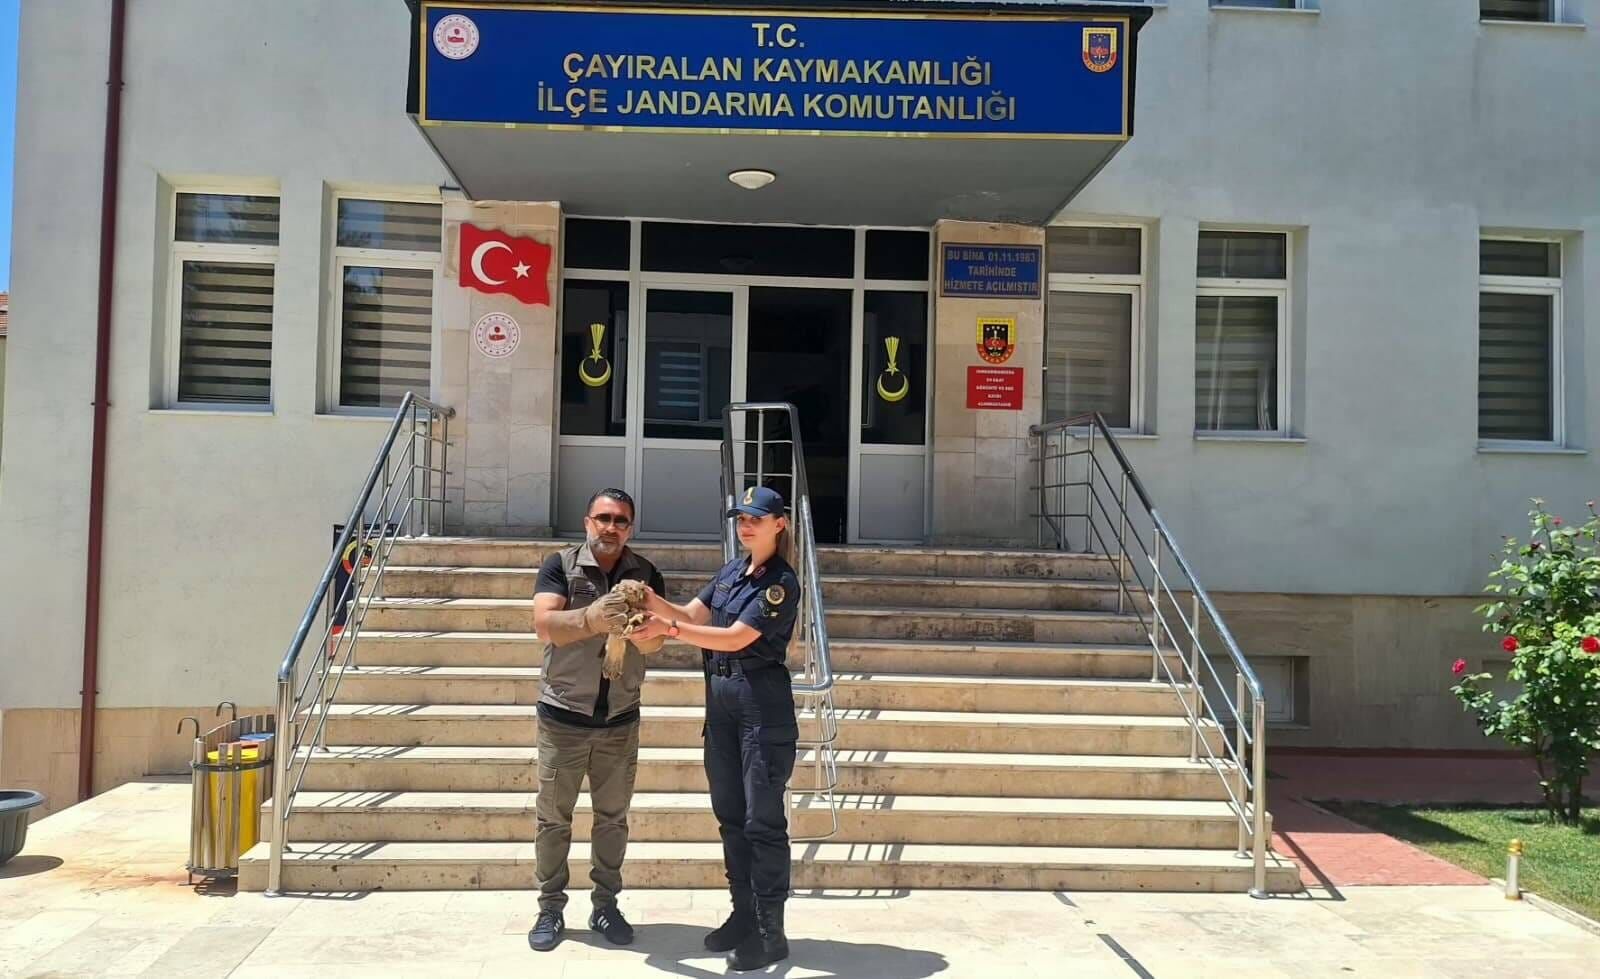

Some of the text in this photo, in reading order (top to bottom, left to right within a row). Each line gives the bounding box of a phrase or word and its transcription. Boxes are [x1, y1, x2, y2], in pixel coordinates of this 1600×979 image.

[752, 23, 805, 49] T.C.
[563, 53, 992, 86] ÇAYIRALAN KAYMAKAMLIĞI
[537, 81, 1016, 122] İLÇE JANDARMA KOMUTANLIĞI
[947, 250, 961, 260] BU
[963, 249, 985, 261] BİNA
[968, 265, 1017, 277] TARİHİNDE
[945, 277, 984, 290] HİZMETE
